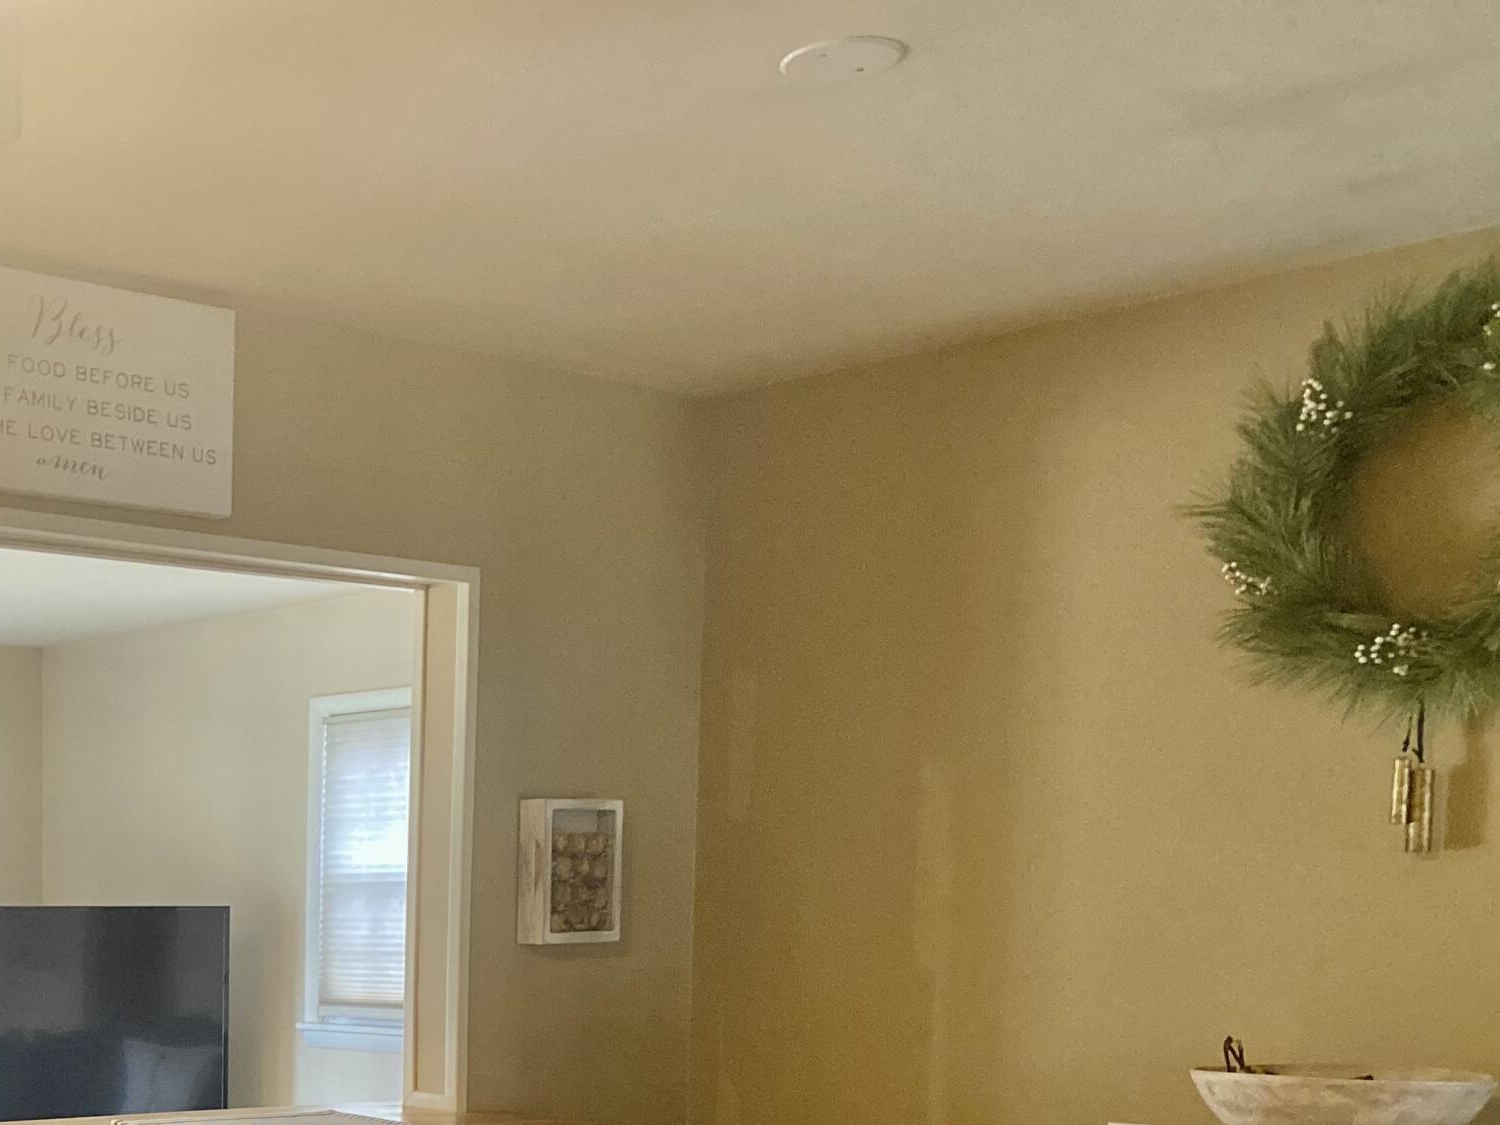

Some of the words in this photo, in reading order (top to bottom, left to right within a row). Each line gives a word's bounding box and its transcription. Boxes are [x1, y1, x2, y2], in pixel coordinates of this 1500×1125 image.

[31, 295, 119, 354] Bless
[7, 354, 66, 378] FOOD
[76, 365, 155, 393] BEFORE
[164, 381, 190, 399] US
[4, 386, 77, 412] FAMILY
[87, 400, 157, 426] BESIDE
[167, 413, 192, 431] US
[28, 423, 81, 446] LOVE
[91, 432, 184, 460] BETWEEN
[192, 447, 217, 465] US
[36, 455, 109, 480] amen
